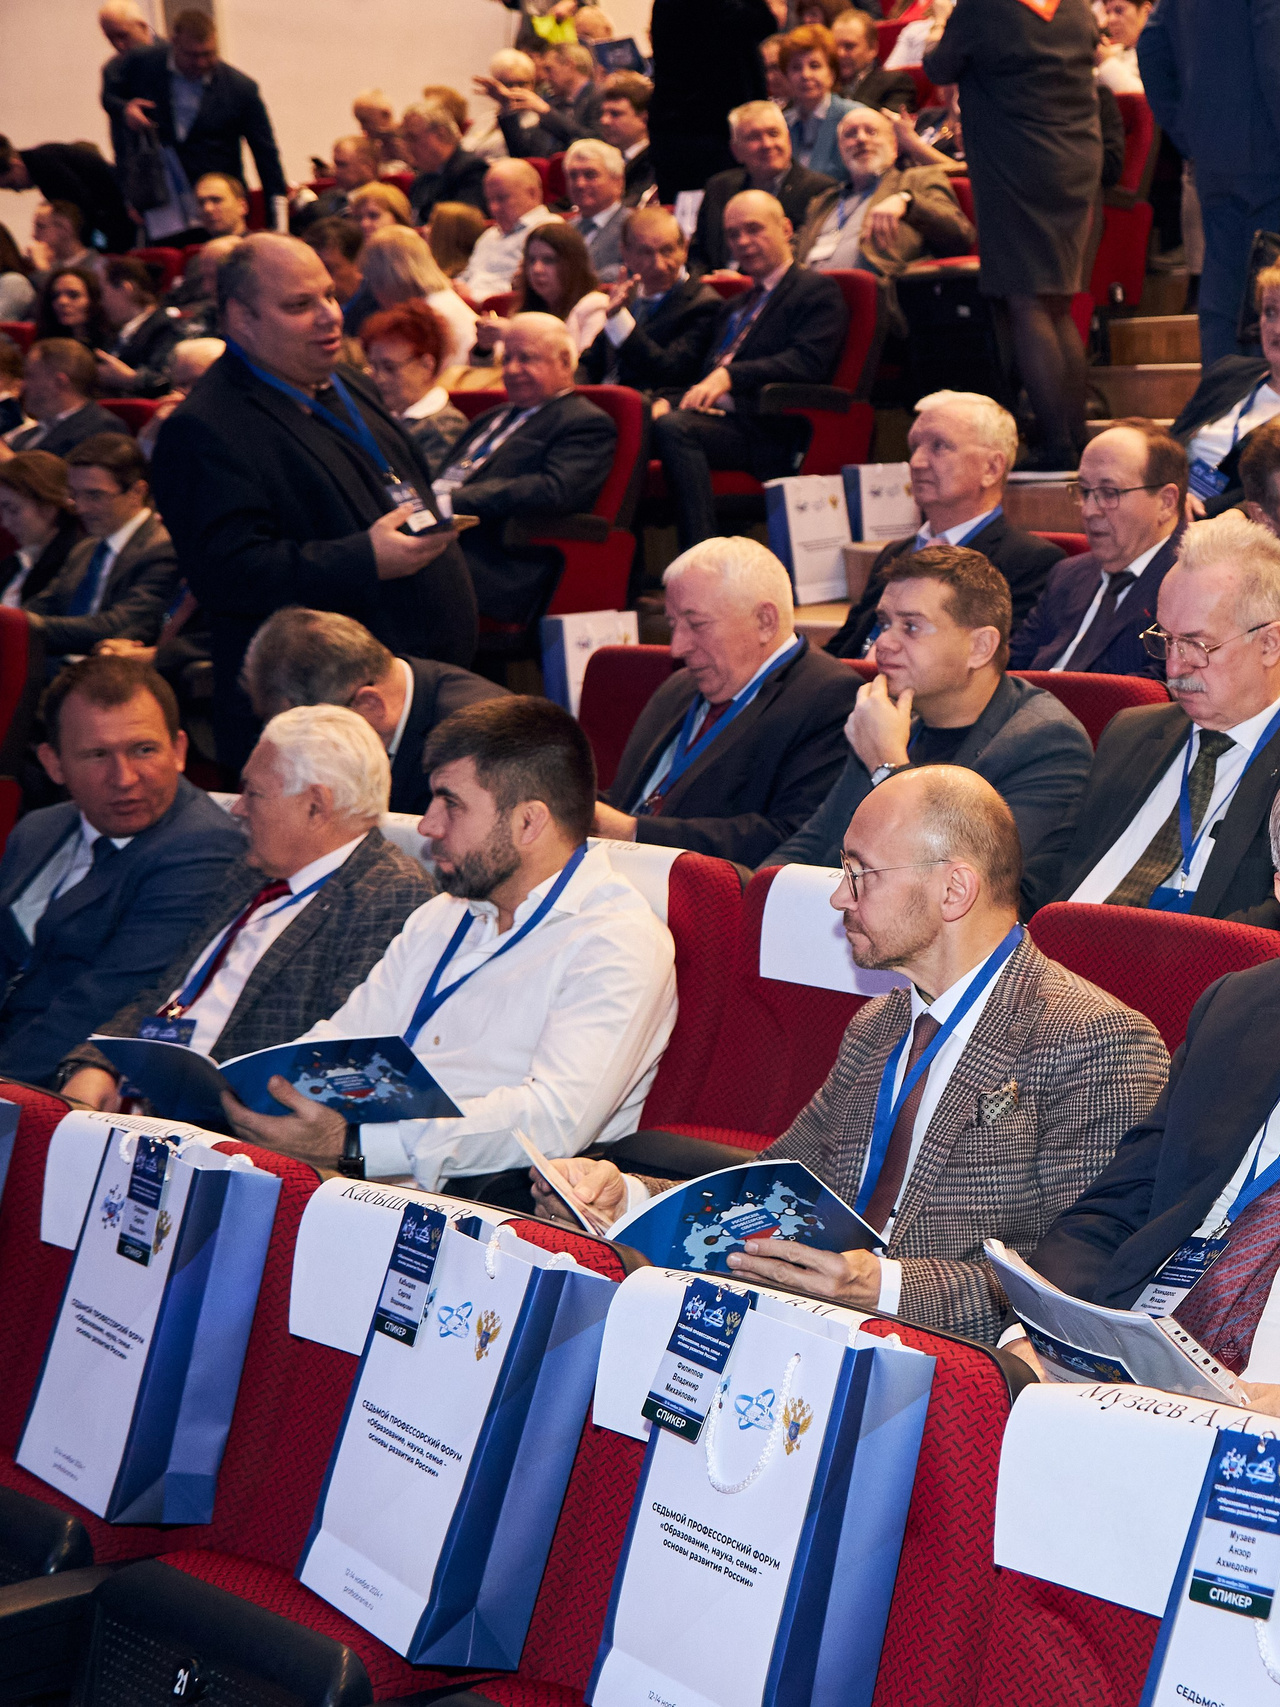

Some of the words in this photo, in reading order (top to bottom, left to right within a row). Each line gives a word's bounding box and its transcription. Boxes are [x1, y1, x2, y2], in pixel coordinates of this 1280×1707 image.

[677, 1362, 704, 1379] Филиппов
[672, 1372, 700, 1392] Владимир
[665, 1383, 698, 1404] Михайлович
[1078, 1385, 1189, 1420] Музаев
[656, 1408, 687, 1429] СПИКЕР
[362, 1400, 390, 1420] СЕДЬМОЙ
[389, 1415, 441, 1450] ПРОФЕССОРСКИЙ
[440, 1444, 463, 1463] ФОРУМ
[368, 1432, 389, 1449] основы
[387, 1445, 415, 1464] развития
[425, 1451, 444, 1467] семья
[652, 1501, 687, 1525] СЕДЬМОЙ
[687, 1518, 752, 1556] ПРОФЕССОРСКИЙ
[752, 1550, 780, 1571] ФОРУМ
[1230, 1530, 1257, 1544] Музаев
[660, 1522, 710, 1554] «Образование,
[711, 1546, 734, 1565] наука,
[735, 1558, 758, 1575] семья
[1229, 1545, 1251, 1559] Анзор
[662, 1539, 689, 1557] основы
[688, 1551, 722, 1573] развития
[723, 1566, 754, 1588] России»
[1216, 1557, 1258, 1575] Ахмедович
[1209, 1587, 1252, 1609] СПИКЕР
[174, 1668, 189, 1695] 21
[1176, 1684, 1225, 1707] СЕДЬМО
